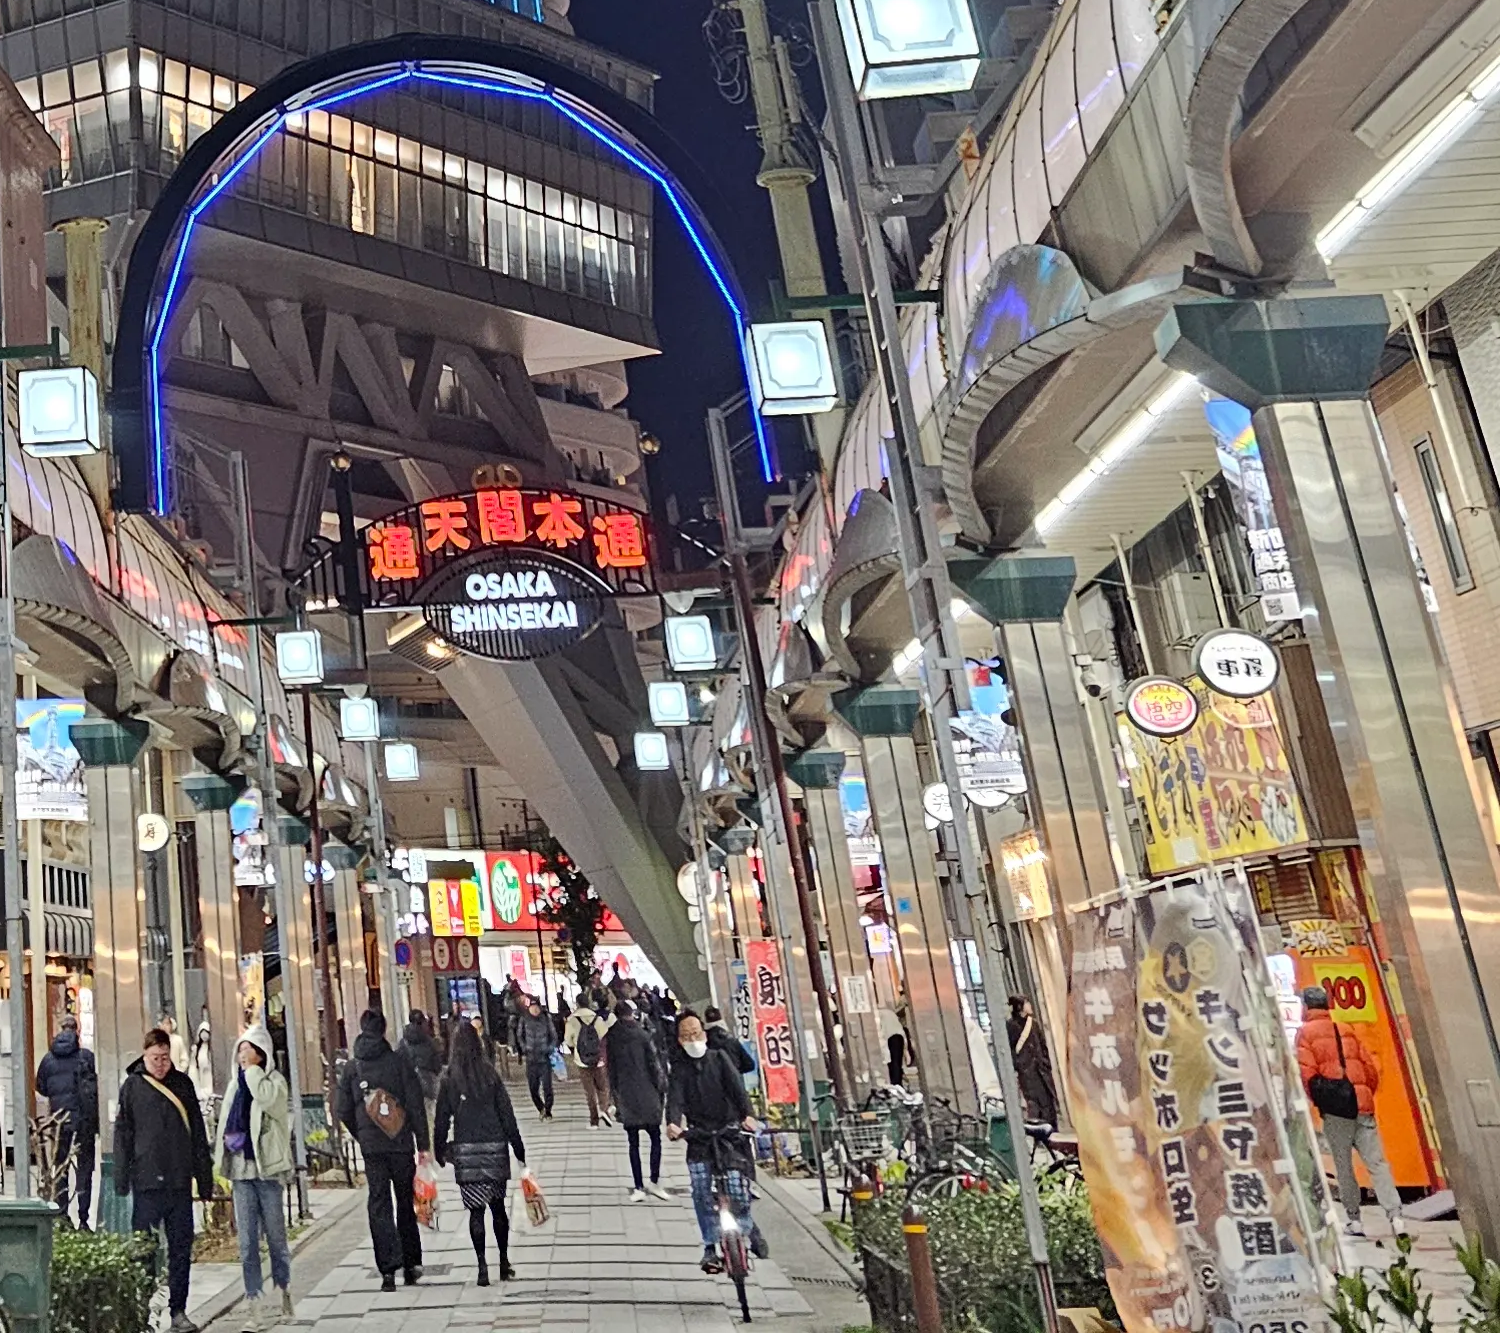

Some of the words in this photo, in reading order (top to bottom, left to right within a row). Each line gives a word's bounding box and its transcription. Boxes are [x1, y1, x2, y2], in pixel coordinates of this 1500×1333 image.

[369, 489, 647, 582] 通天閣本通
[465, 571, 557, 601] OSAKA
[451, 601, 579, 633] SHINSEKAI
[1322, 975, 1366, 1010] 100
[758, 965, 794, 1067] 射的
